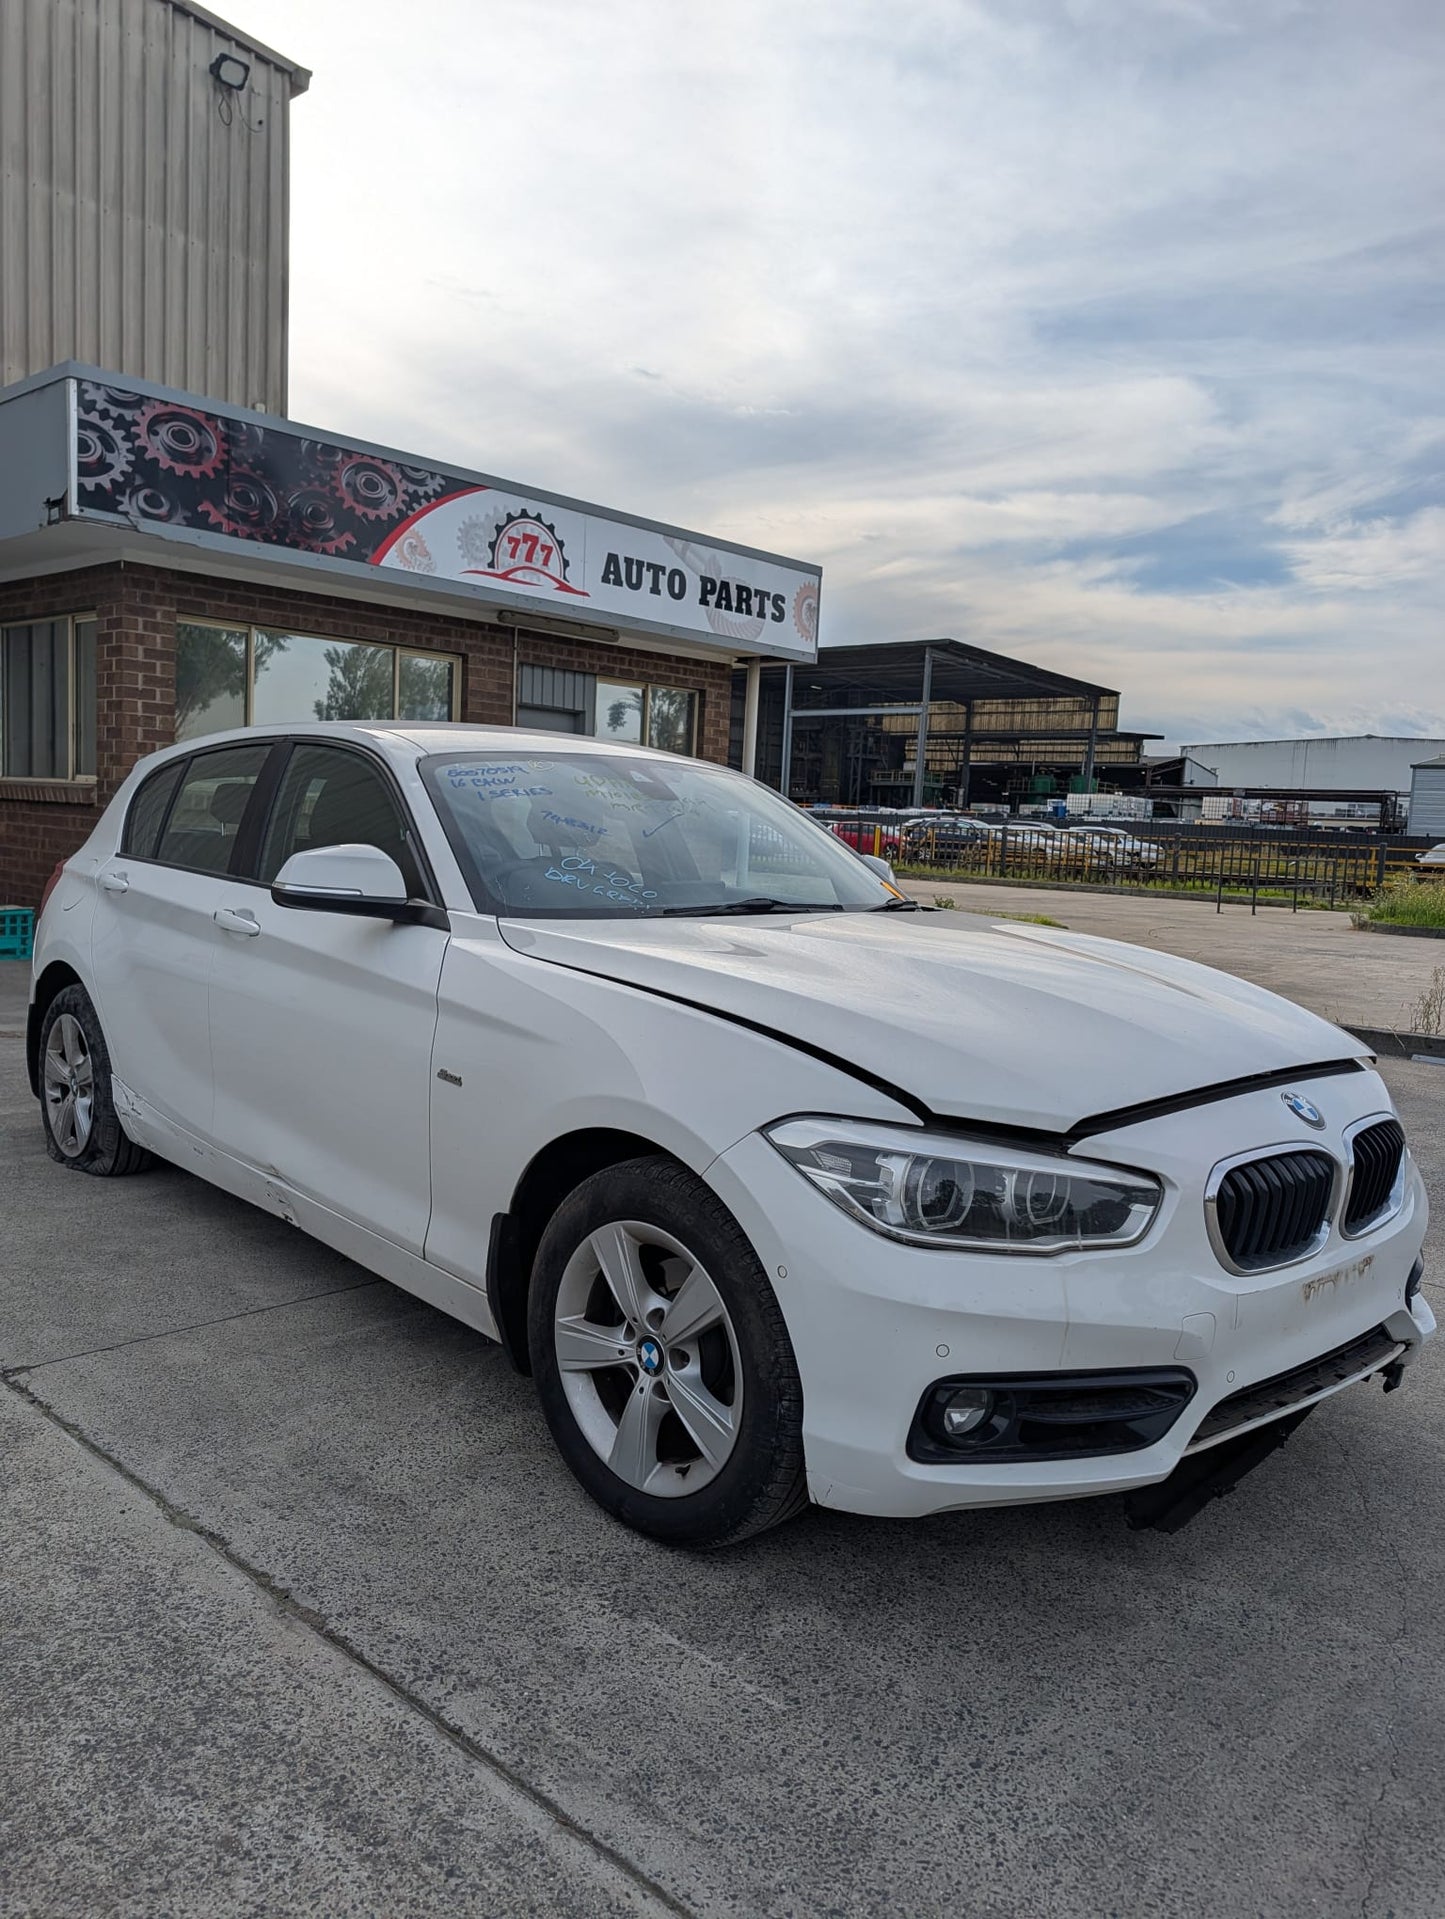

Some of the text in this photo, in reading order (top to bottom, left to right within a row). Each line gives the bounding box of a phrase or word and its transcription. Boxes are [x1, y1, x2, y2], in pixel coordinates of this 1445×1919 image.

[507, 532, 554, 567] 777
[601, 552, 786, 623] AUTO PARTS
[488, 786, 554, 800] SERIES
